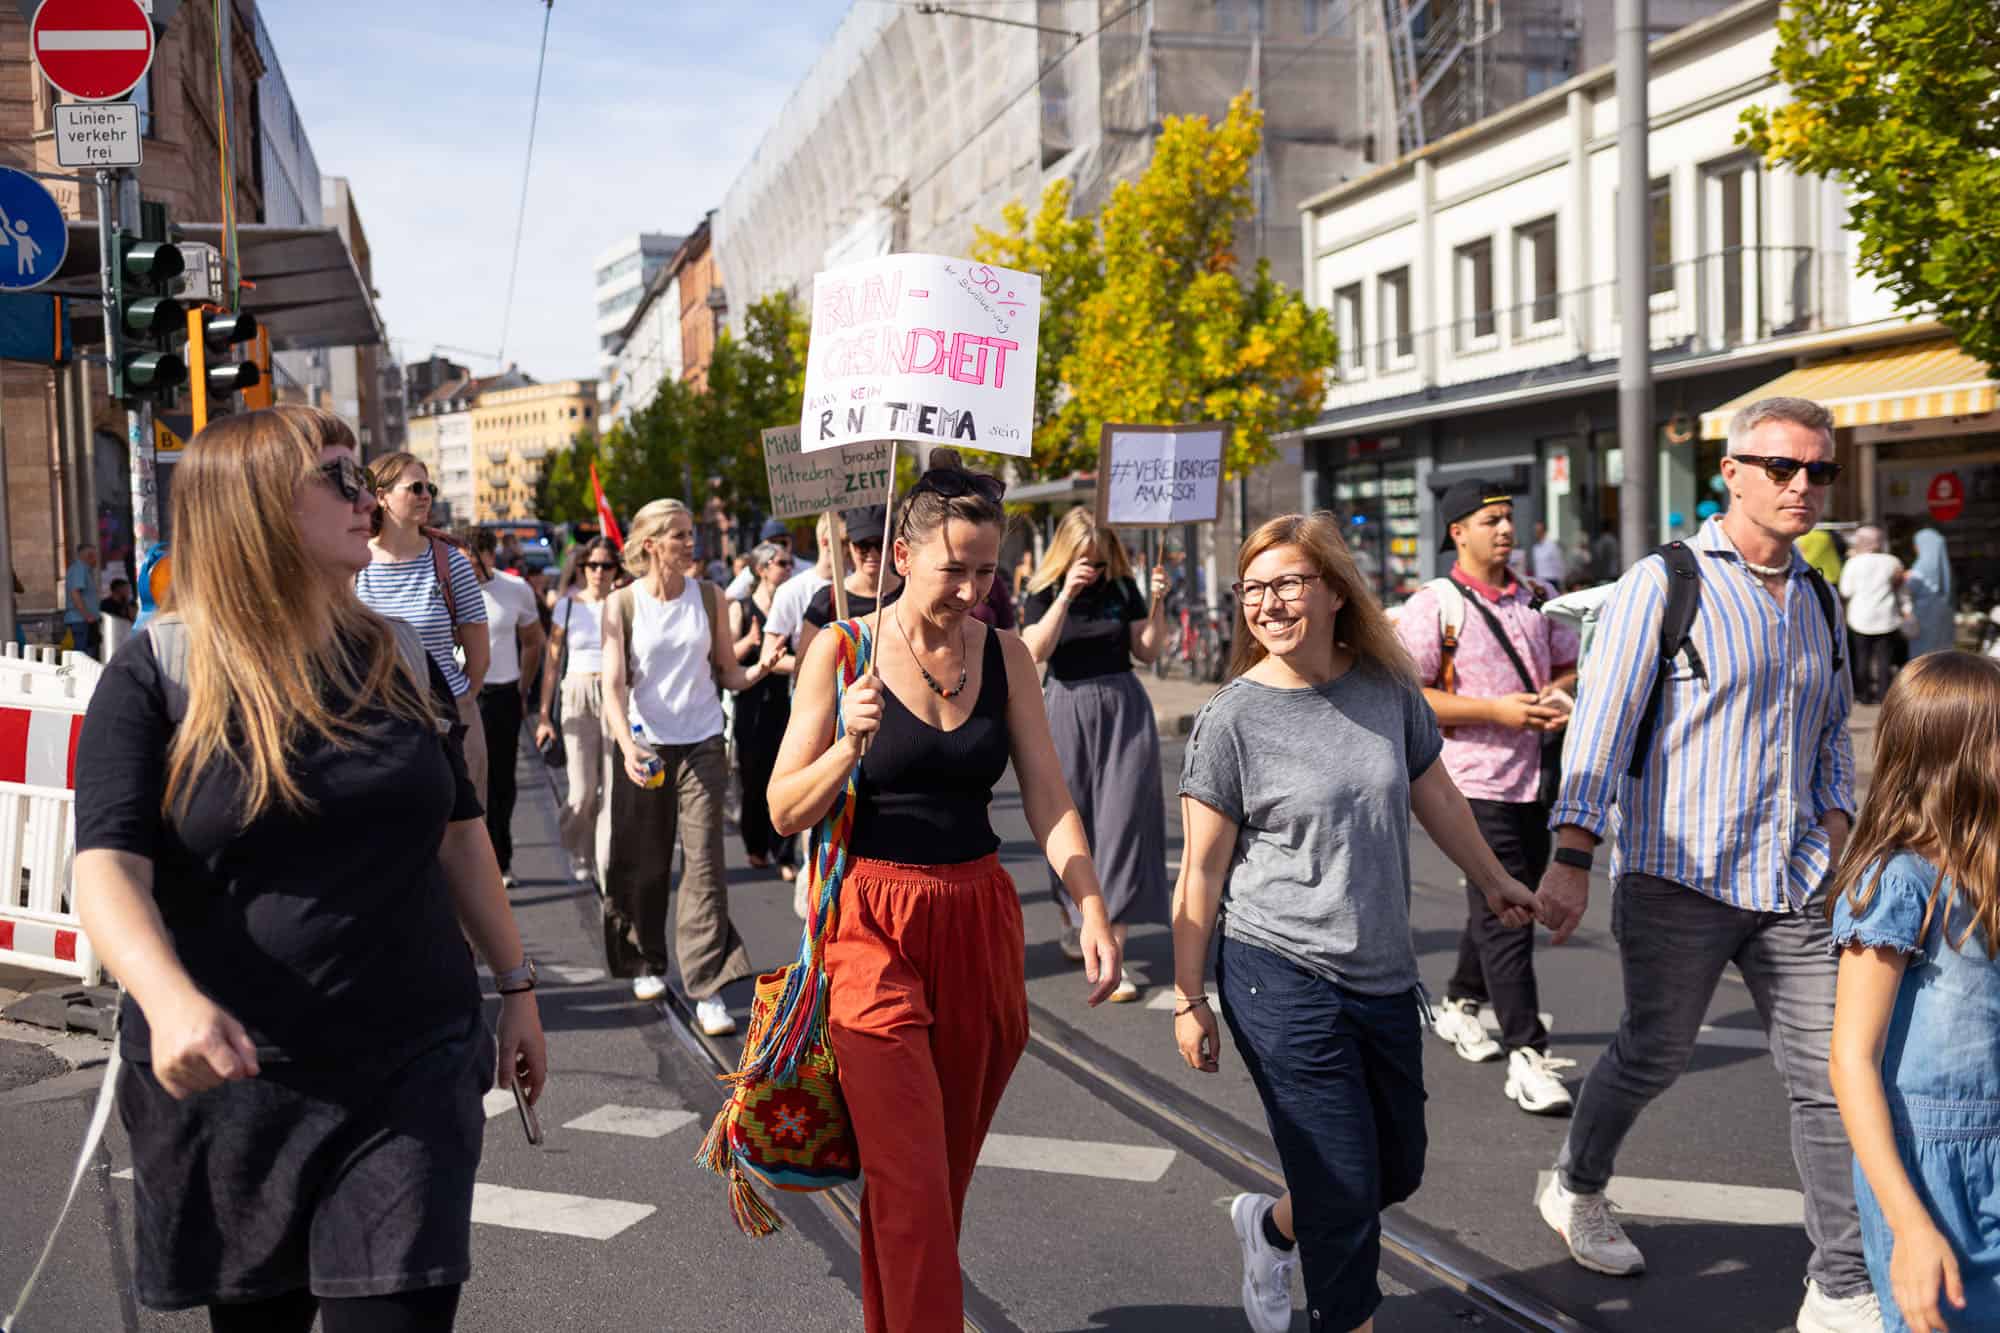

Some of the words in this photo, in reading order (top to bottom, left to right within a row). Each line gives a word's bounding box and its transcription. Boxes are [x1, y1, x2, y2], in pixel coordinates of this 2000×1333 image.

[69, 111, 123, 125] Linien-
[68, 128, 127, 142] verkehr
[86, 145, 112, 159] frei
[766, 431, 801, 456] Mitd
[841, 443, 887, 466] braucht
[769, 460, 832, 488] Mitreden
[845, 470, 889, 493] ZEIT
[774, 487, 848, 514] Mitmachen
